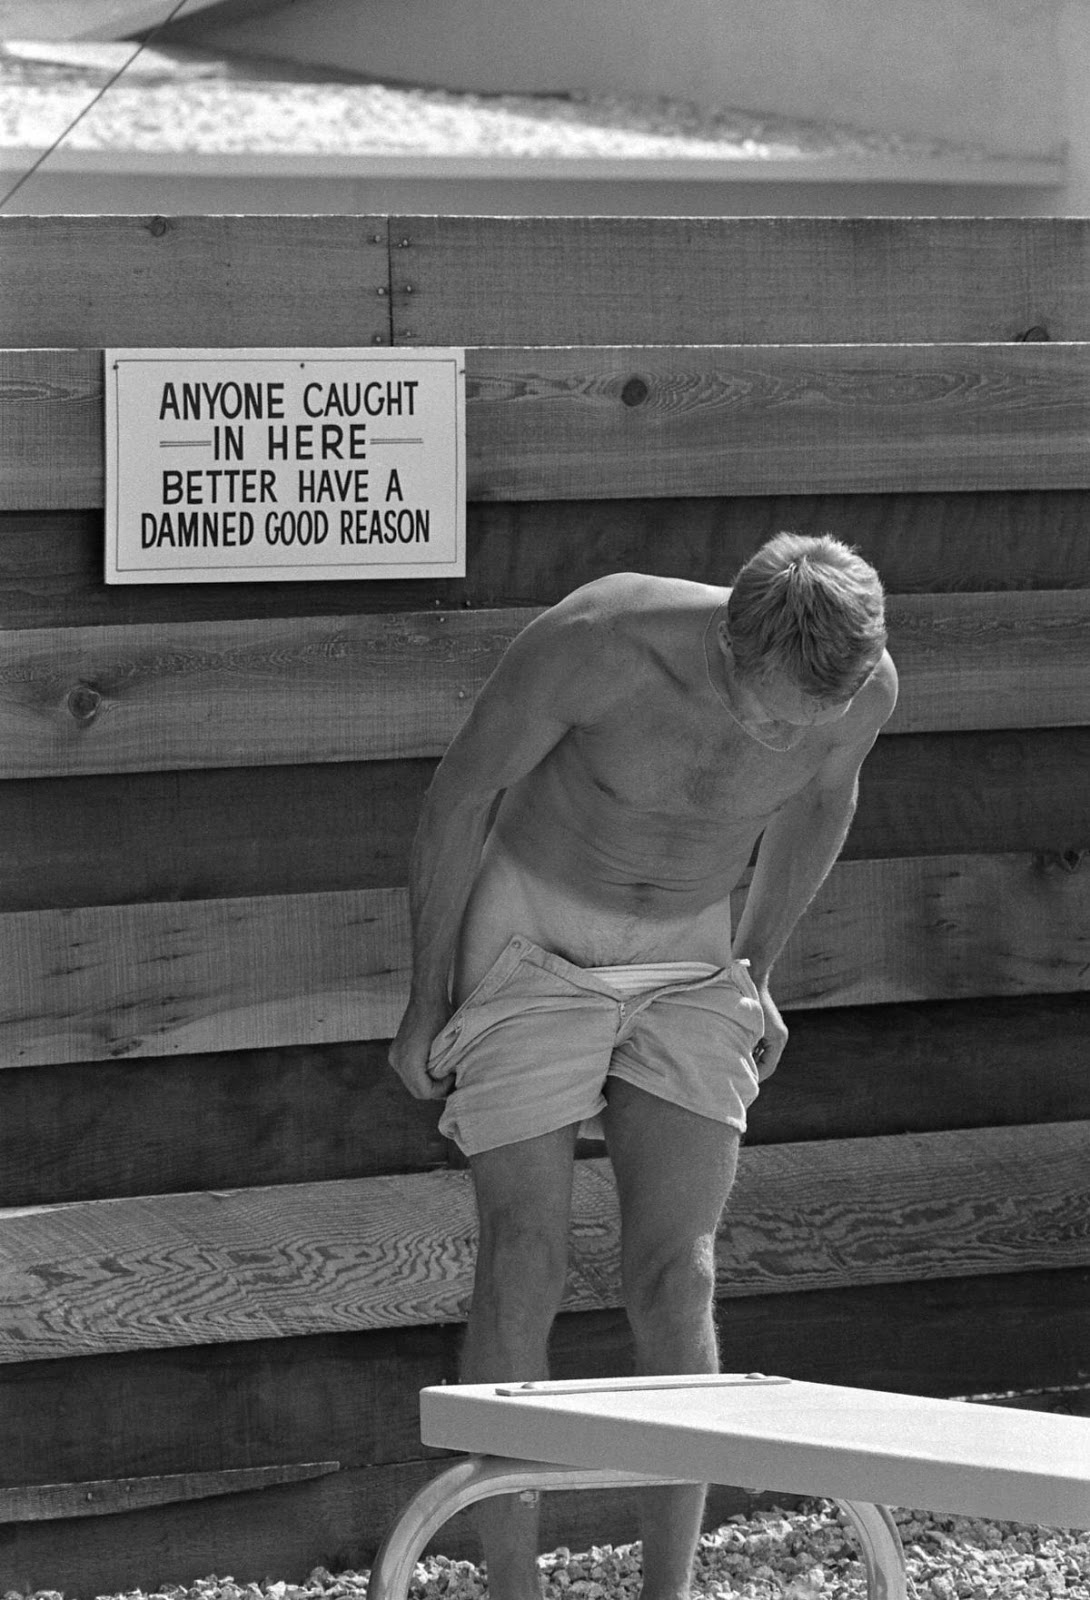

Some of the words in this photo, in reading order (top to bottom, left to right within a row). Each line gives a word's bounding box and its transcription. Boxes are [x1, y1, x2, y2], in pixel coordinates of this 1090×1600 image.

[158, 382, 285, 421] ANYONE
[303, 380, 419, 418] CAUGHT
[213, 425, 244, 461] IN
[268, 423, 367, 461] HERE
[162, 469, 278, 505] BETTER
[298, 469, 369, 503] HAVE
[385, 468, 404, 503] A
[141, 511, 255, 550] DAMNED
[264, 509, 329, 547] GOOD
[340, 508, 430, 546] REASON
